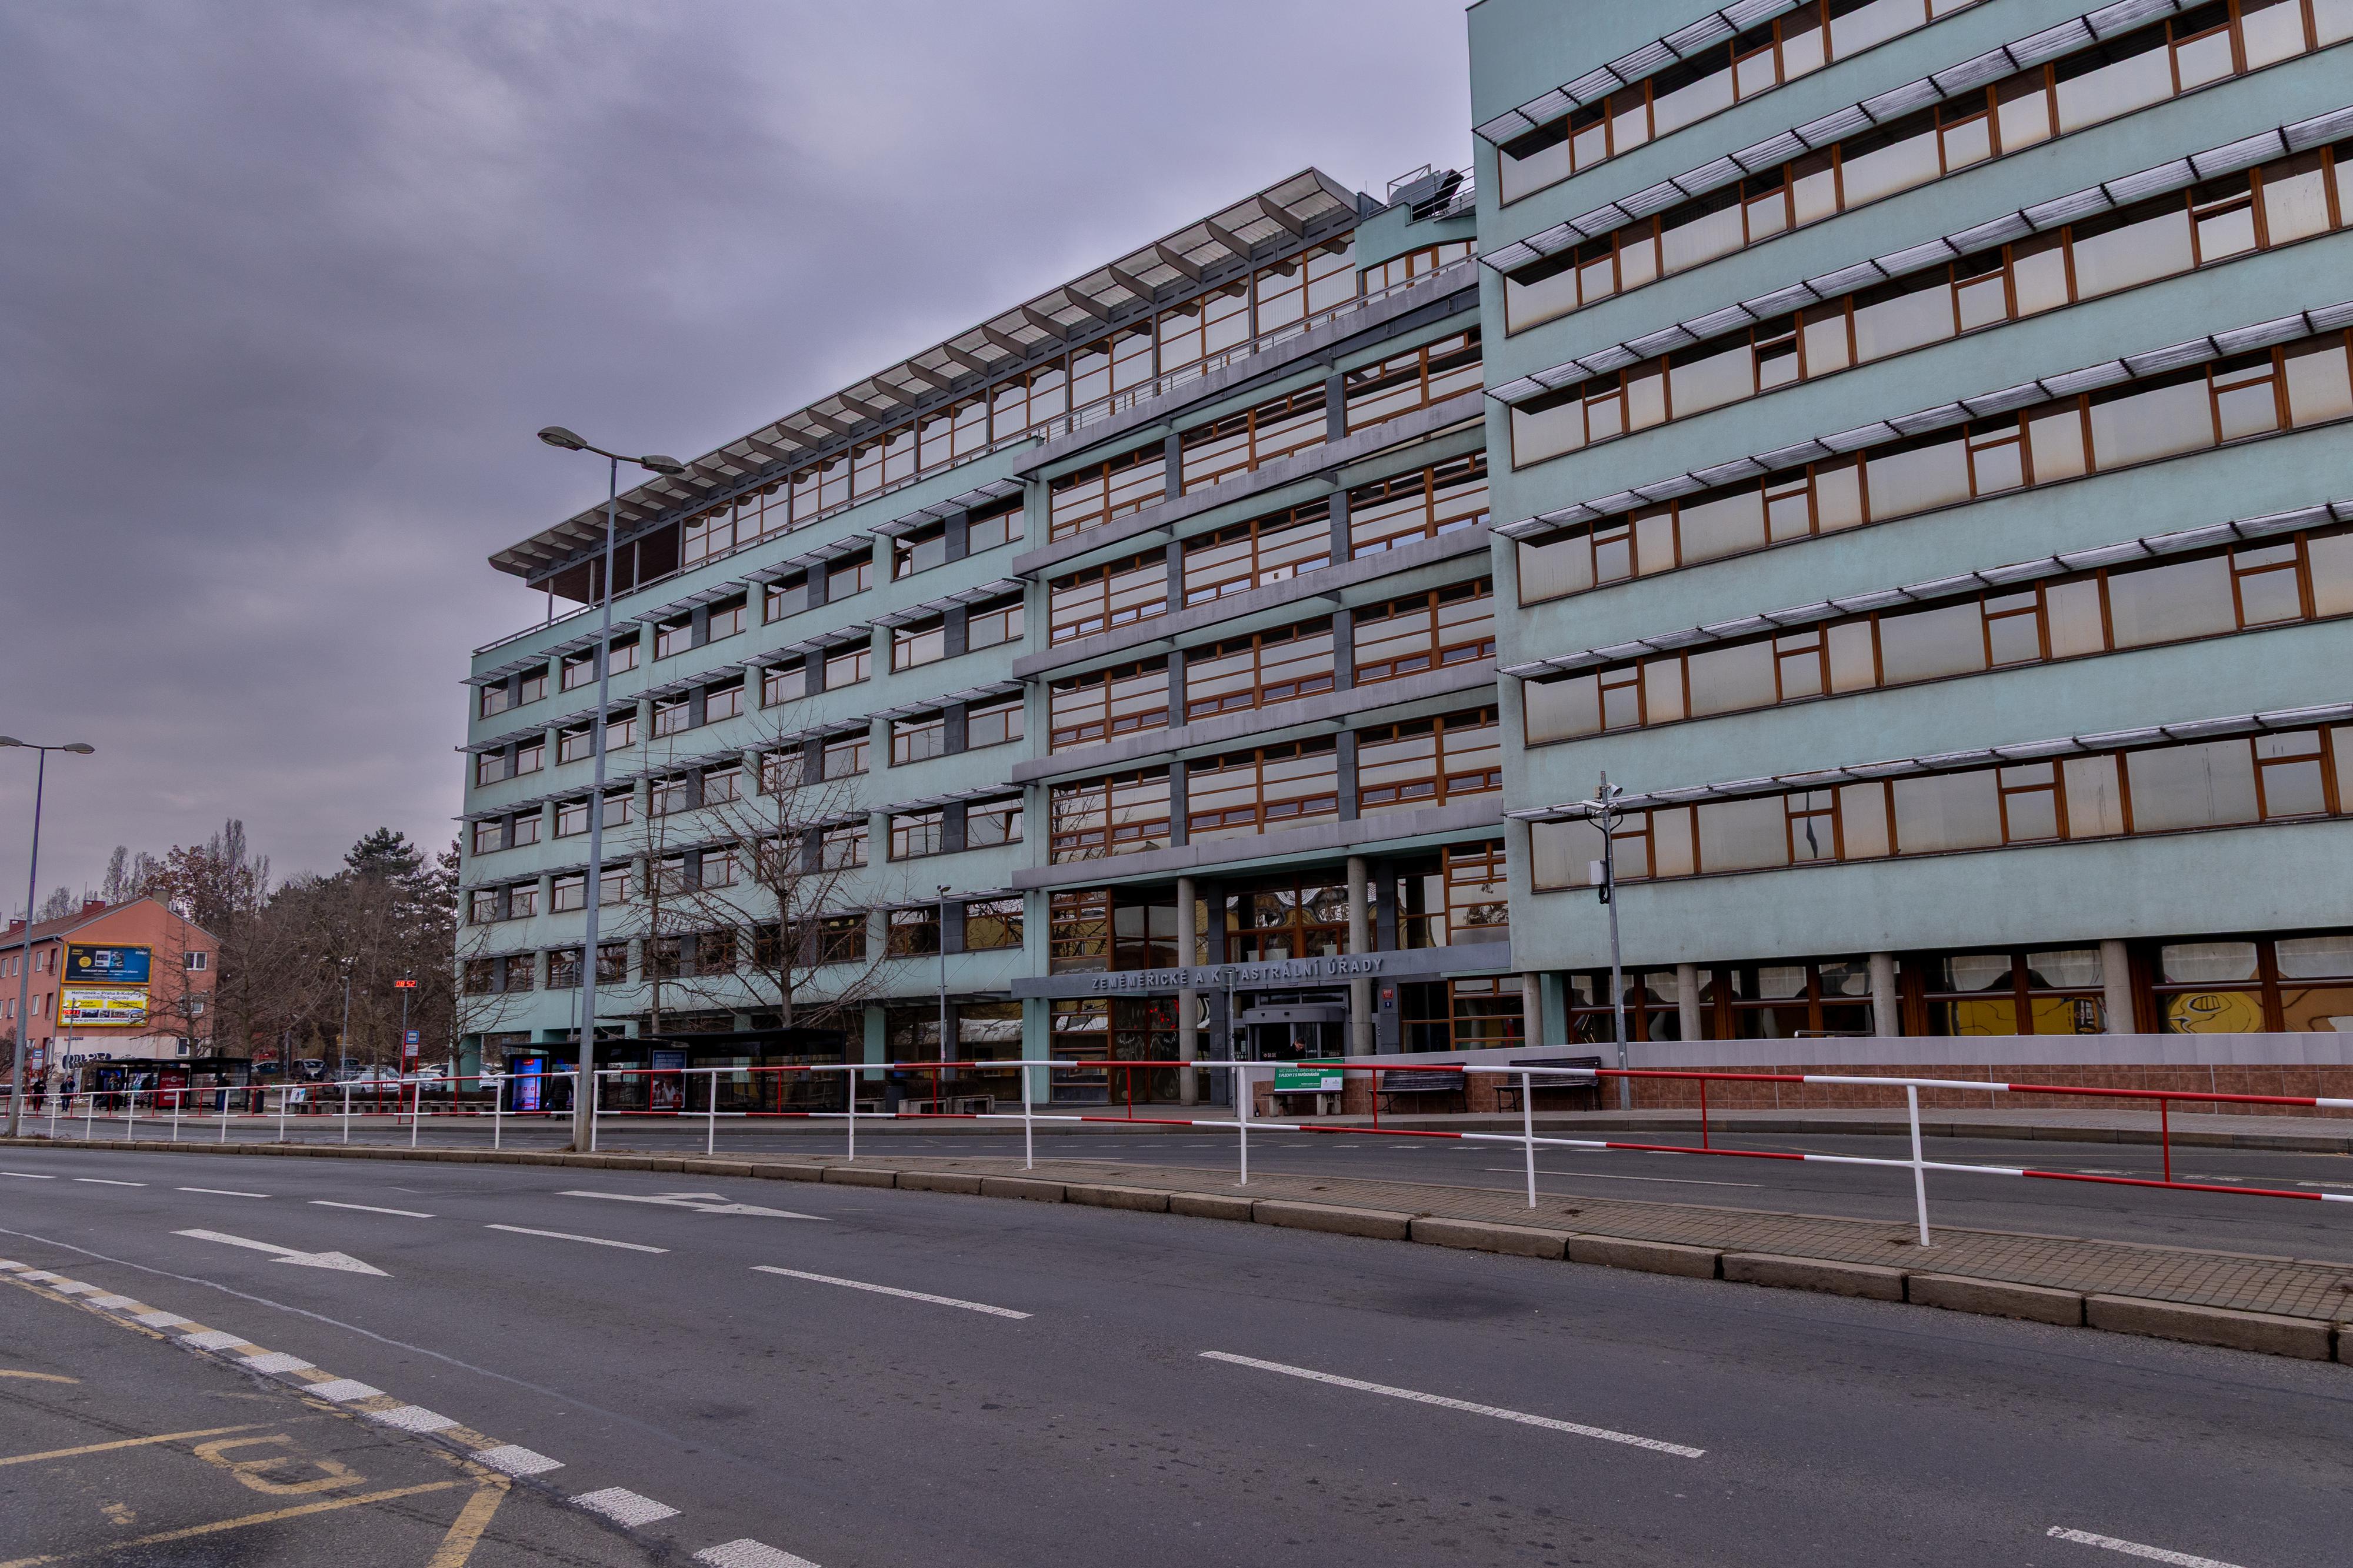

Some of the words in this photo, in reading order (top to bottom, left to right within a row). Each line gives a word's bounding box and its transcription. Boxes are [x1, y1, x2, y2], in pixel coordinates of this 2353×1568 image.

[1196, 972, 1204, 983] A
[1211, 959, 1319, 982] KASTRÁLNÍ
[1327, 958, 1382, 974] ÚŘADY
